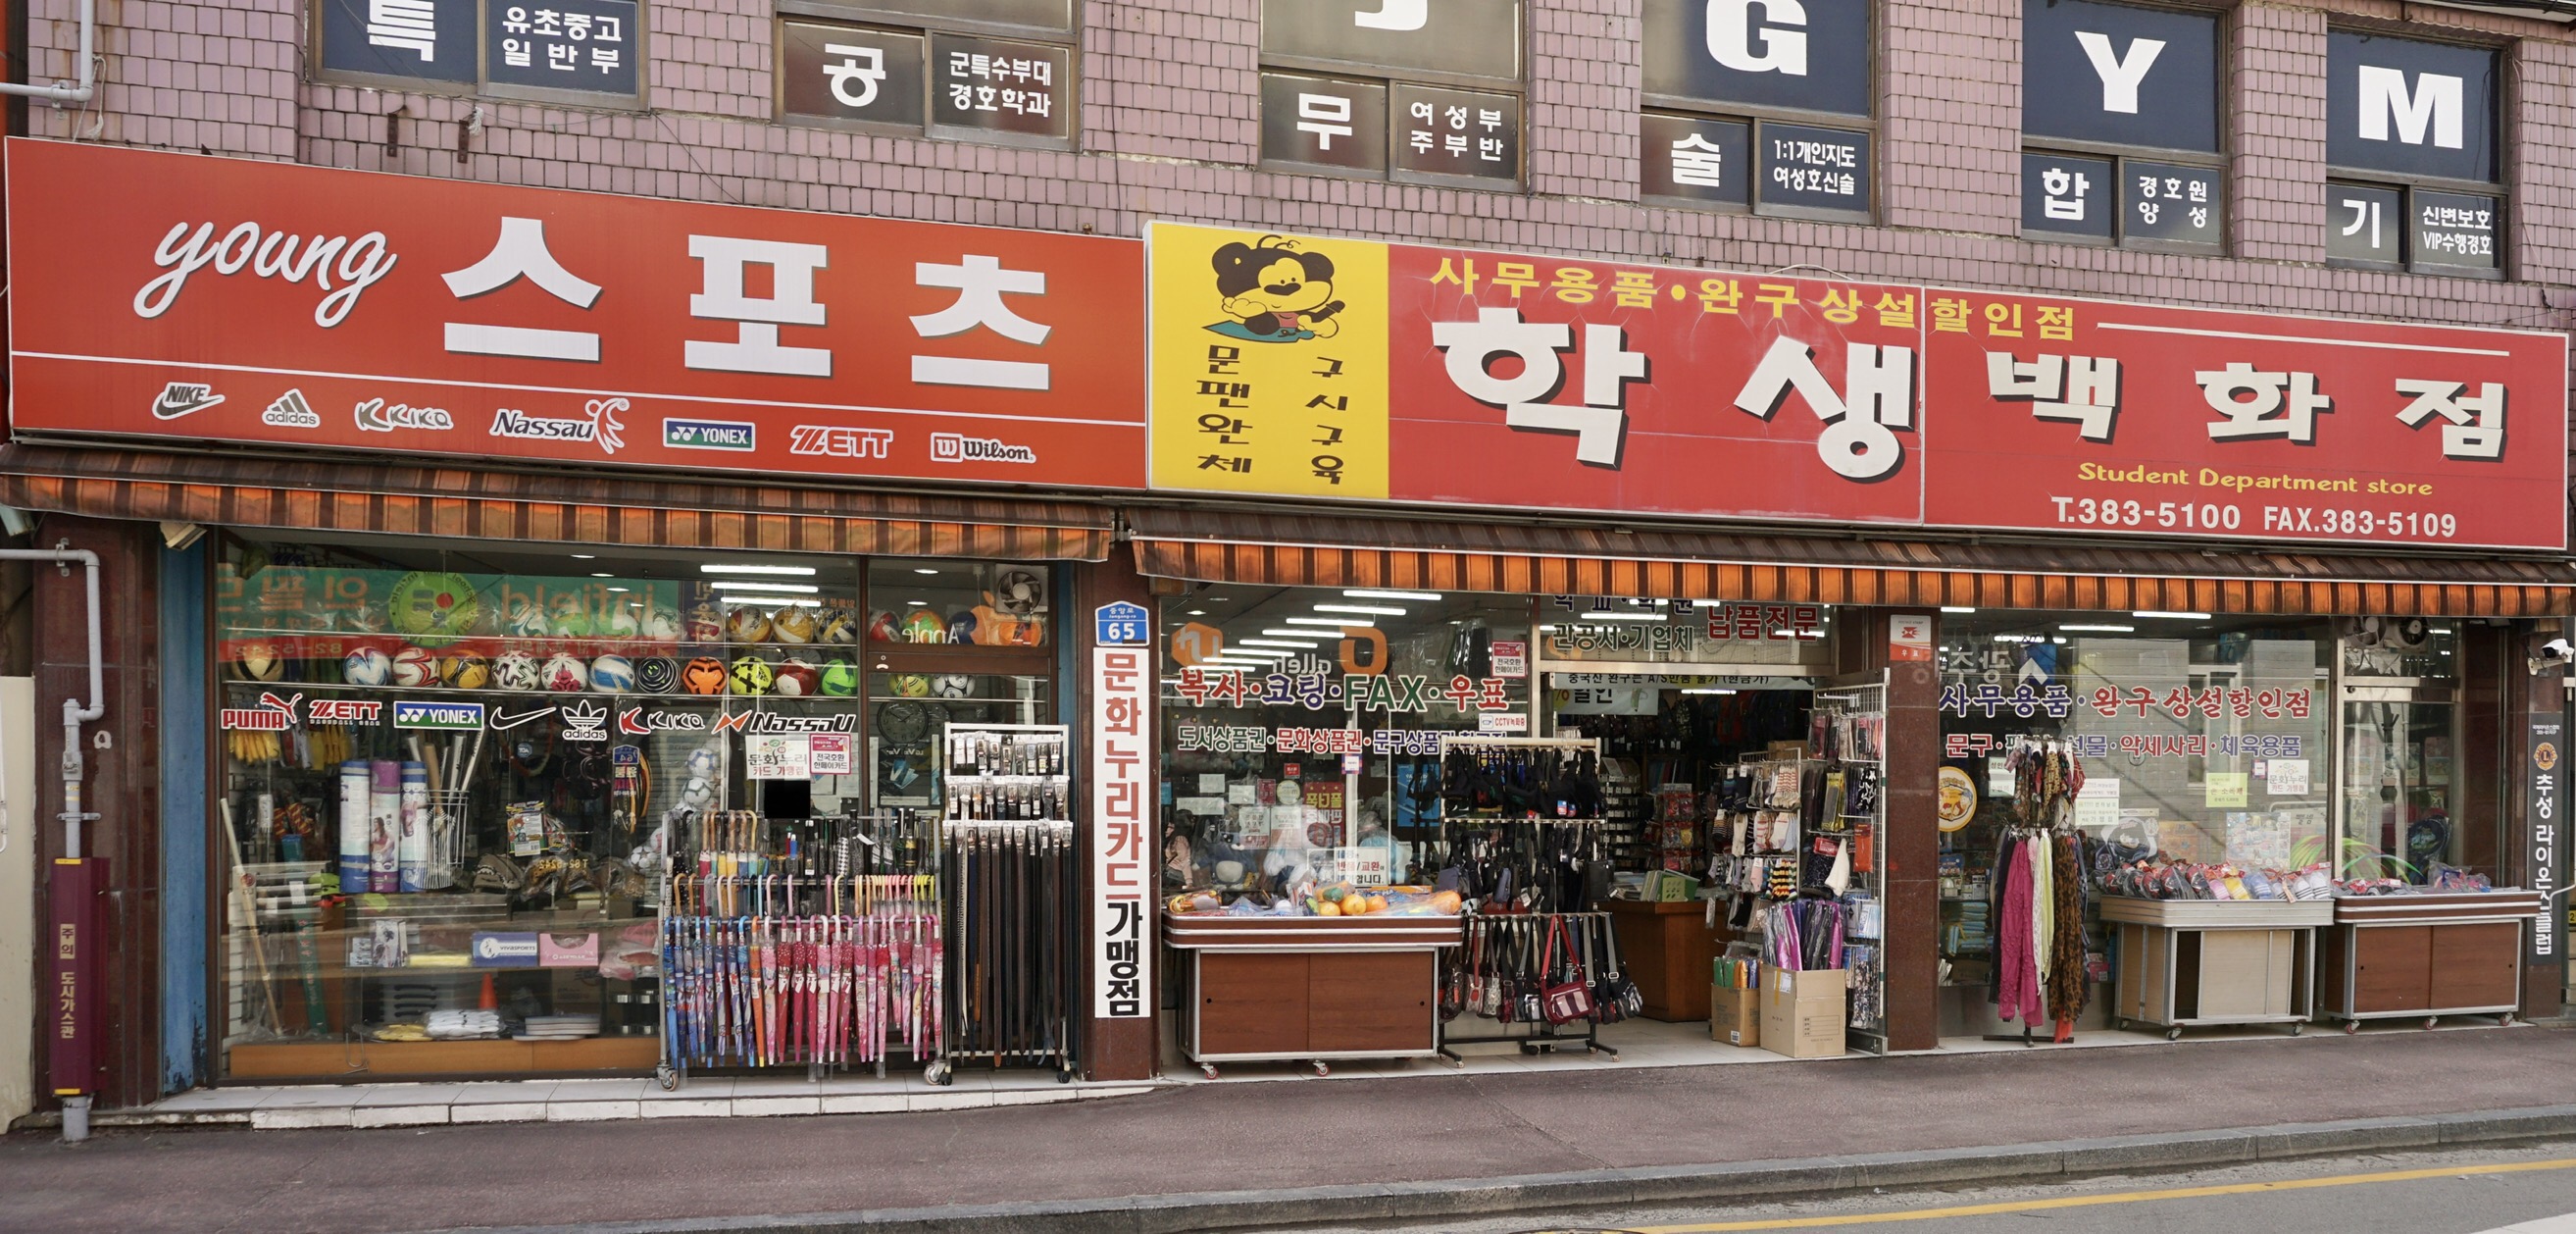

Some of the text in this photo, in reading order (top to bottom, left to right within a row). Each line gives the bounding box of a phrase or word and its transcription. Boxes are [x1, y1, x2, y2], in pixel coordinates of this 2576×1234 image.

[368, 0, 435, 62] 특
[502, 6, 623, 42] 유초중고
[1706, 0, 1807, 76] G
[823, 43, 886, 107] 공
[949, 52, 1051, 86] 군특수부대
[2074, 31, 2166, 114] Y
[949, 83, 1051, 118] 경호학과
[2359, 65, 2463, 149] M
[1296, 93, 1352, 151] 무
[1671, 132, 1721, 187] 술
[1774, 169, 1855, 196] 여성호신술
[2042, 168, 2090, 221] 합
[2343, 199, 2381, 249] 기
[2422, 205, 2492, 231] 신변보호
[132, 222, 398, 329] young
[165, 385, 208, 404] NIKE
[265, 410, 318, 427] adidas
[492, 409, 594, 438] Nassau
[700, 426, 749, 445] YONEX
[790, 426, 893, 458] ZETT
[963, 439, 1030, 461] Wilson
[2077, 461, 2434, 496] Student Department store
[1108, 622, 1136, 640] 65
[1706, 604, 1820, 642] 납품전문
[222, 708, 287, 730] PUMA
[309, 699, 382, 720] ZETT
[429, 708, 478, 724] YONEX
[562, 728, 607, 741] adidas
[60, 927, 76, 1039] 주의 도시가스관
